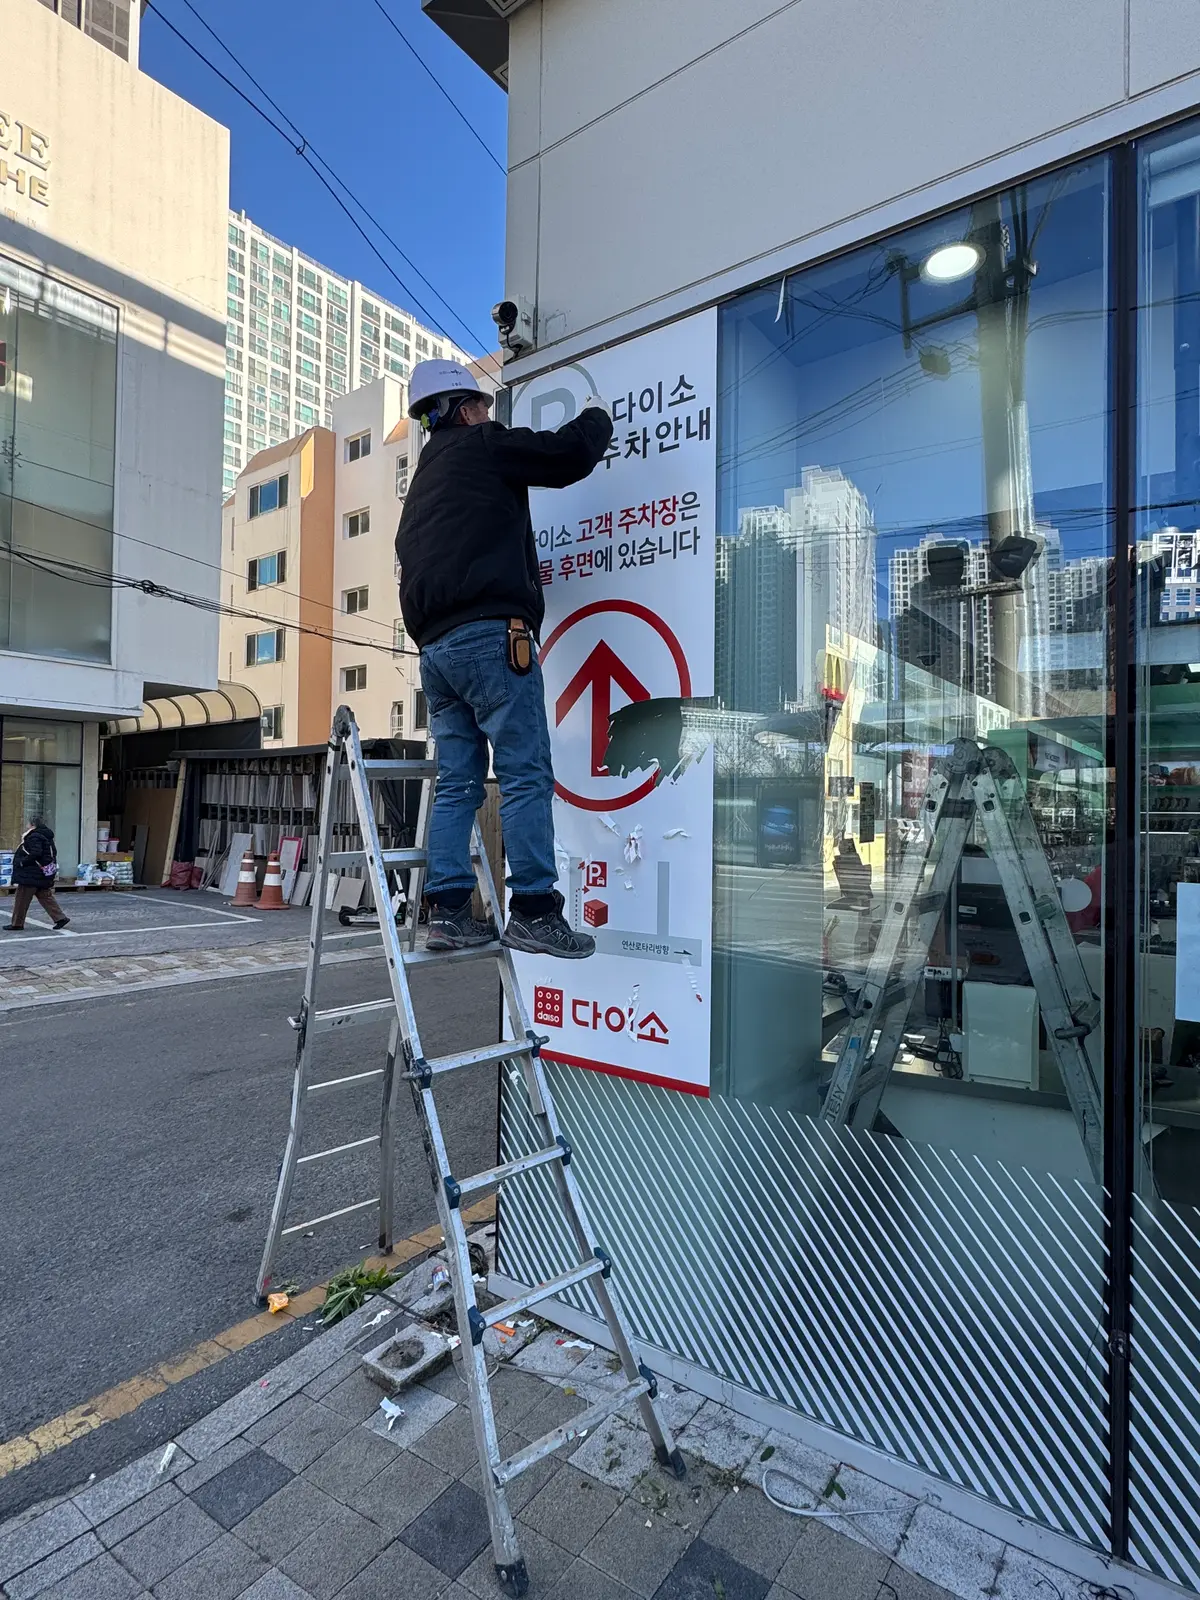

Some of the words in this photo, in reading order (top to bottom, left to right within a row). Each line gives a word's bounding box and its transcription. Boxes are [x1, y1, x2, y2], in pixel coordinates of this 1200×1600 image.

[612, 374, 697, 424] 다이소
[533, 525, 573, 552] 이소
[576, 511, 613, 543] 고객
[618, 491, 701, 535] 주차장은
[558, 545, 613, 581] 후면에
[618, 526, 701, 570] 있습니다
[621, 940, 670, 956] 연산로타리방향
[537, 1011, 560, 1023] daiso
